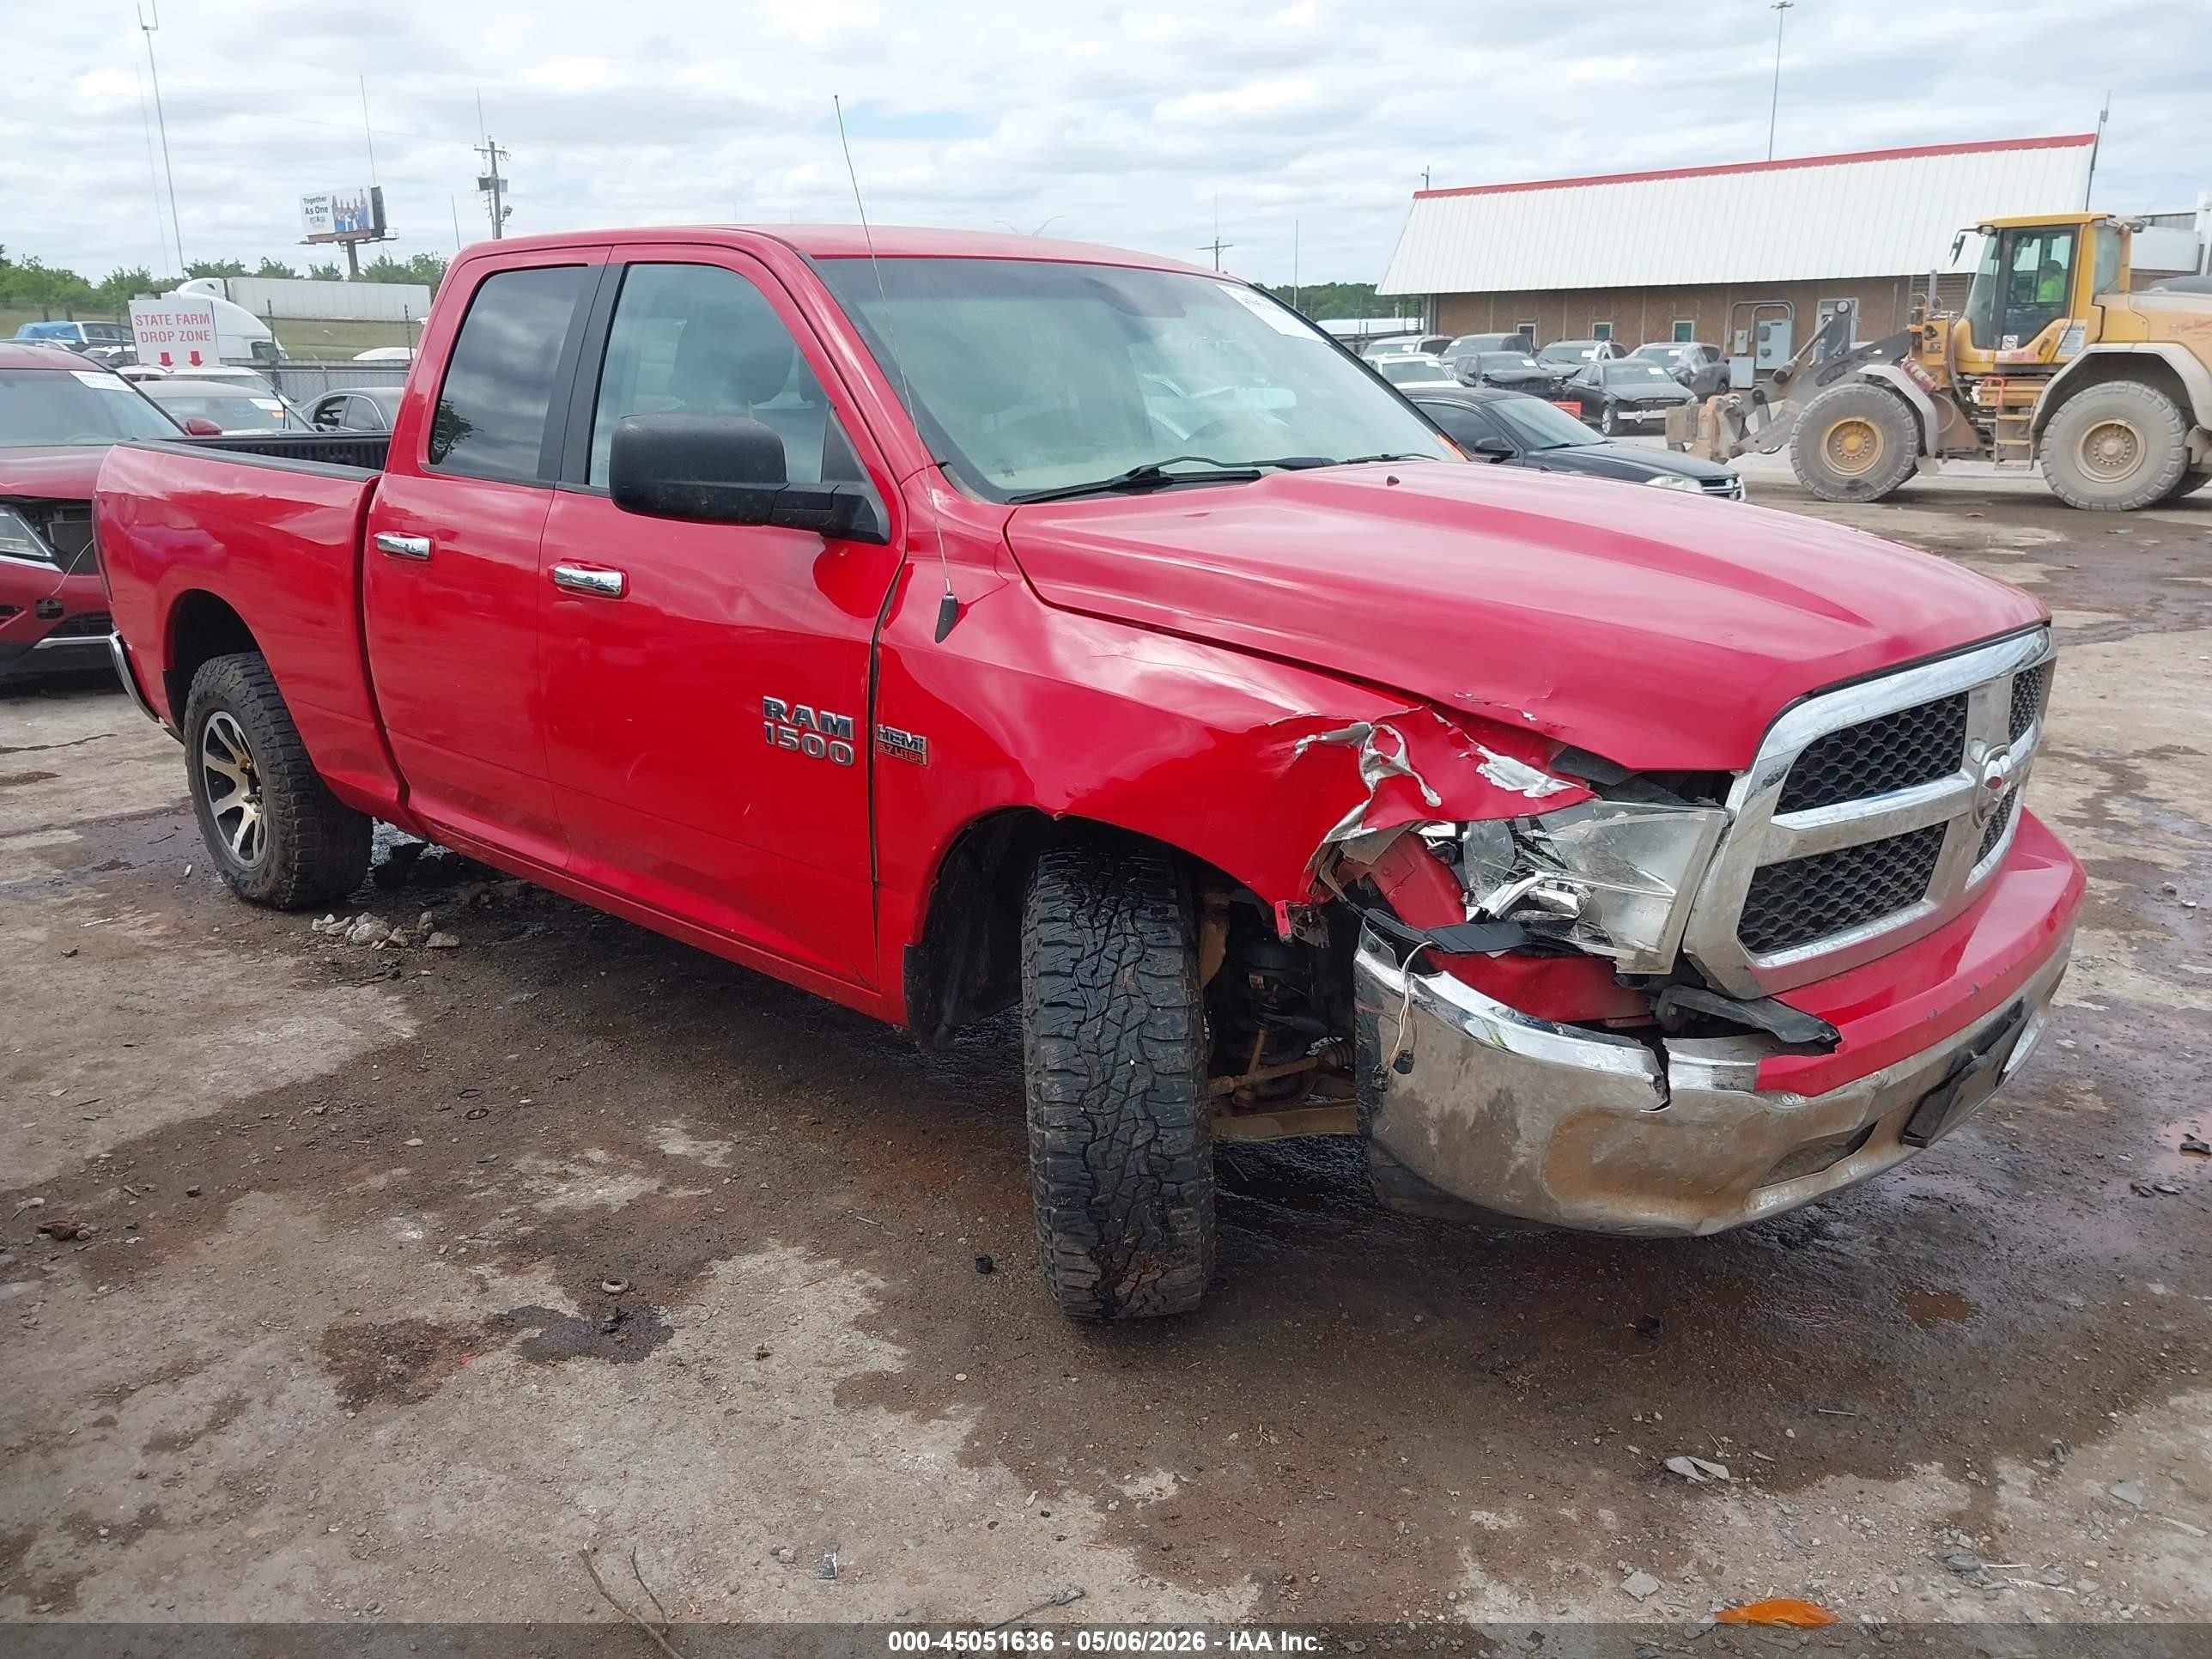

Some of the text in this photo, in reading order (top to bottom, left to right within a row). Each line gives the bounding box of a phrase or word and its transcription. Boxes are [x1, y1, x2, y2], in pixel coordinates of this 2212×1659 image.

[303, 196, 327, 205] Together
[305, 205, 329, 215] As One
[135, 313, 210, 326] STATE FARM
[140, 330, 211, 343] DROP ZONE
[763, 696, 854, 740] RAM
[763, 721, 855, 767] 1500
[877, 723, 927, 752] HEMI
[894, 747, 923, 764] LITER
